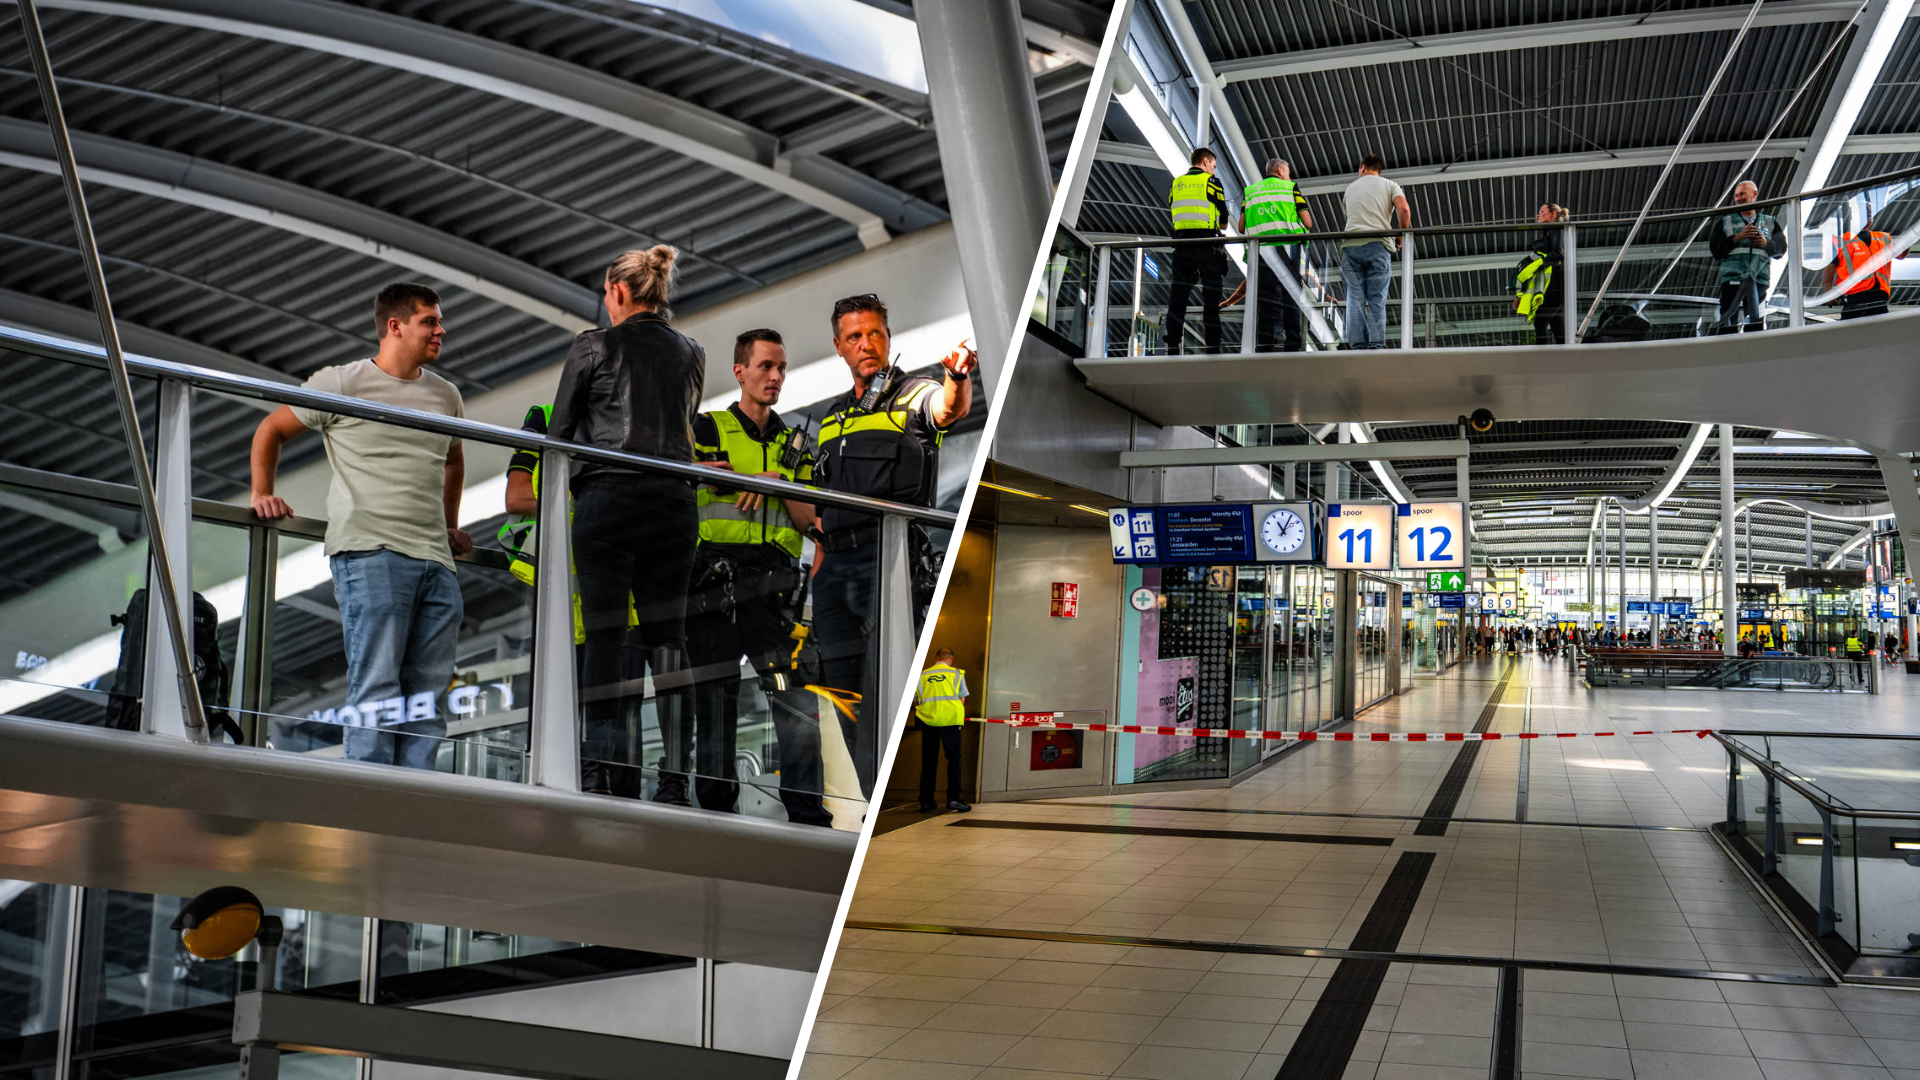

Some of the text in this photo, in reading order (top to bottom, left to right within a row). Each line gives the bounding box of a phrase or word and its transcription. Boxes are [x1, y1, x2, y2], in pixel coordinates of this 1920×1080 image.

[1342, 509, 1363, 517] spoor
[1412, 507, 1433, 515] spoor
[1338, 528, 1372, 563] 11
[1408, 525, 1453, 562] 12
[1487, 599, 1494, 608] 8
[1505, 599, 1512, 608] 9
